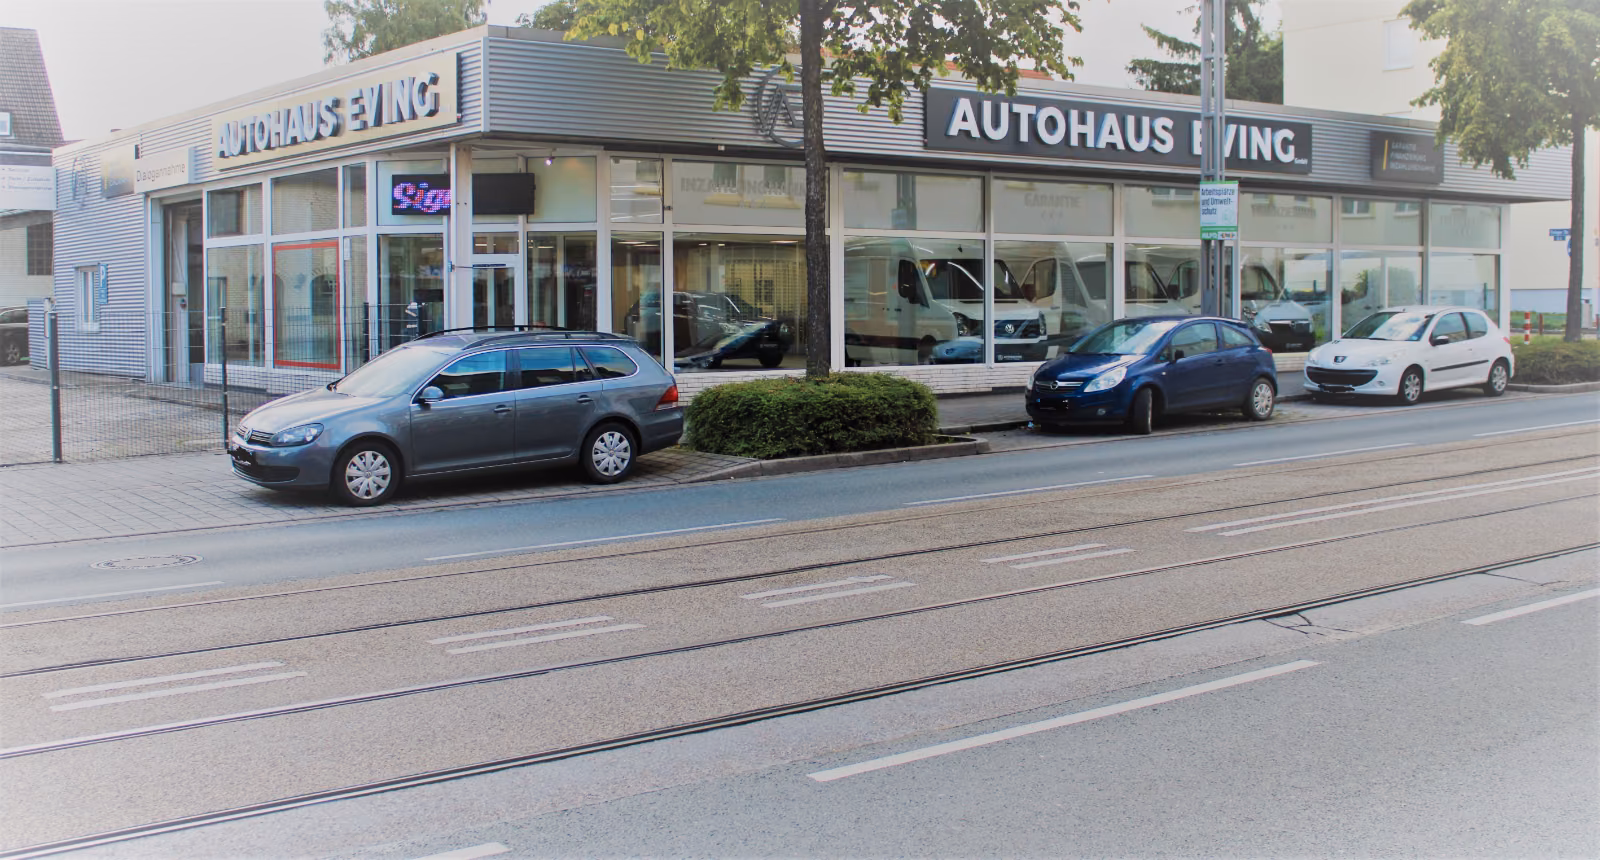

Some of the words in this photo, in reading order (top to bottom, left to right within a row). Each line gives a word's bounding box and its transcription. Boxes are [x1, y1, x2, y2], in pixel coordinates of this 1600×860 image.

[218, 96, 341, 159] AUTOHAUS
[348, 71, 440, 131] EVING
[946, 97, 1174, 154] AUTOHAUS
[136, 163, 186, 182] Dialogannahme
[1201, 188, 1235, 196] Arbeitsplätze
[1201, 197, 1210, 206] und
[1211, 197, 1233, 206] Umwelt-
[1201, 207, 1217, 216] schutz
